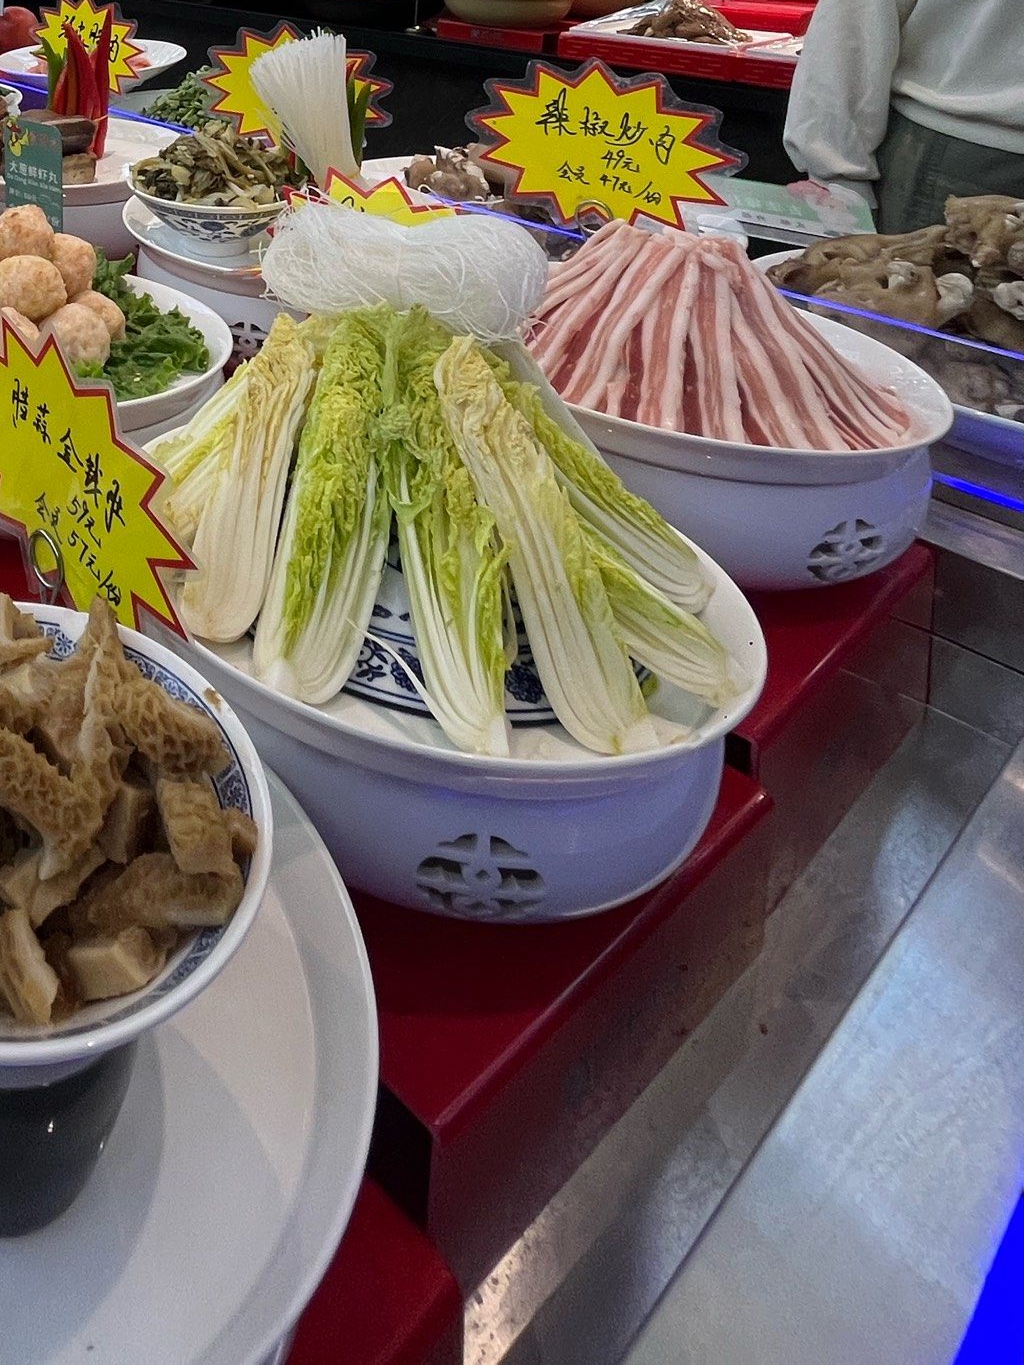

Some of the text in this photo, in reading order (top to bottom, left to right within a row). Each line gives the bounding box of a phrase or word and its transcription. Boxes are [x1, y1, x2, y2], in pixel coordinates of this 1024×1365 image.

[535, 87, 676, 165] 辣椒炒肉
[556, 160, 590, 186] 会员
[600, 149, 640, 174] 49元
[34, 492, 63, 546] 会员
[67, 496, 102, 549] 59元
